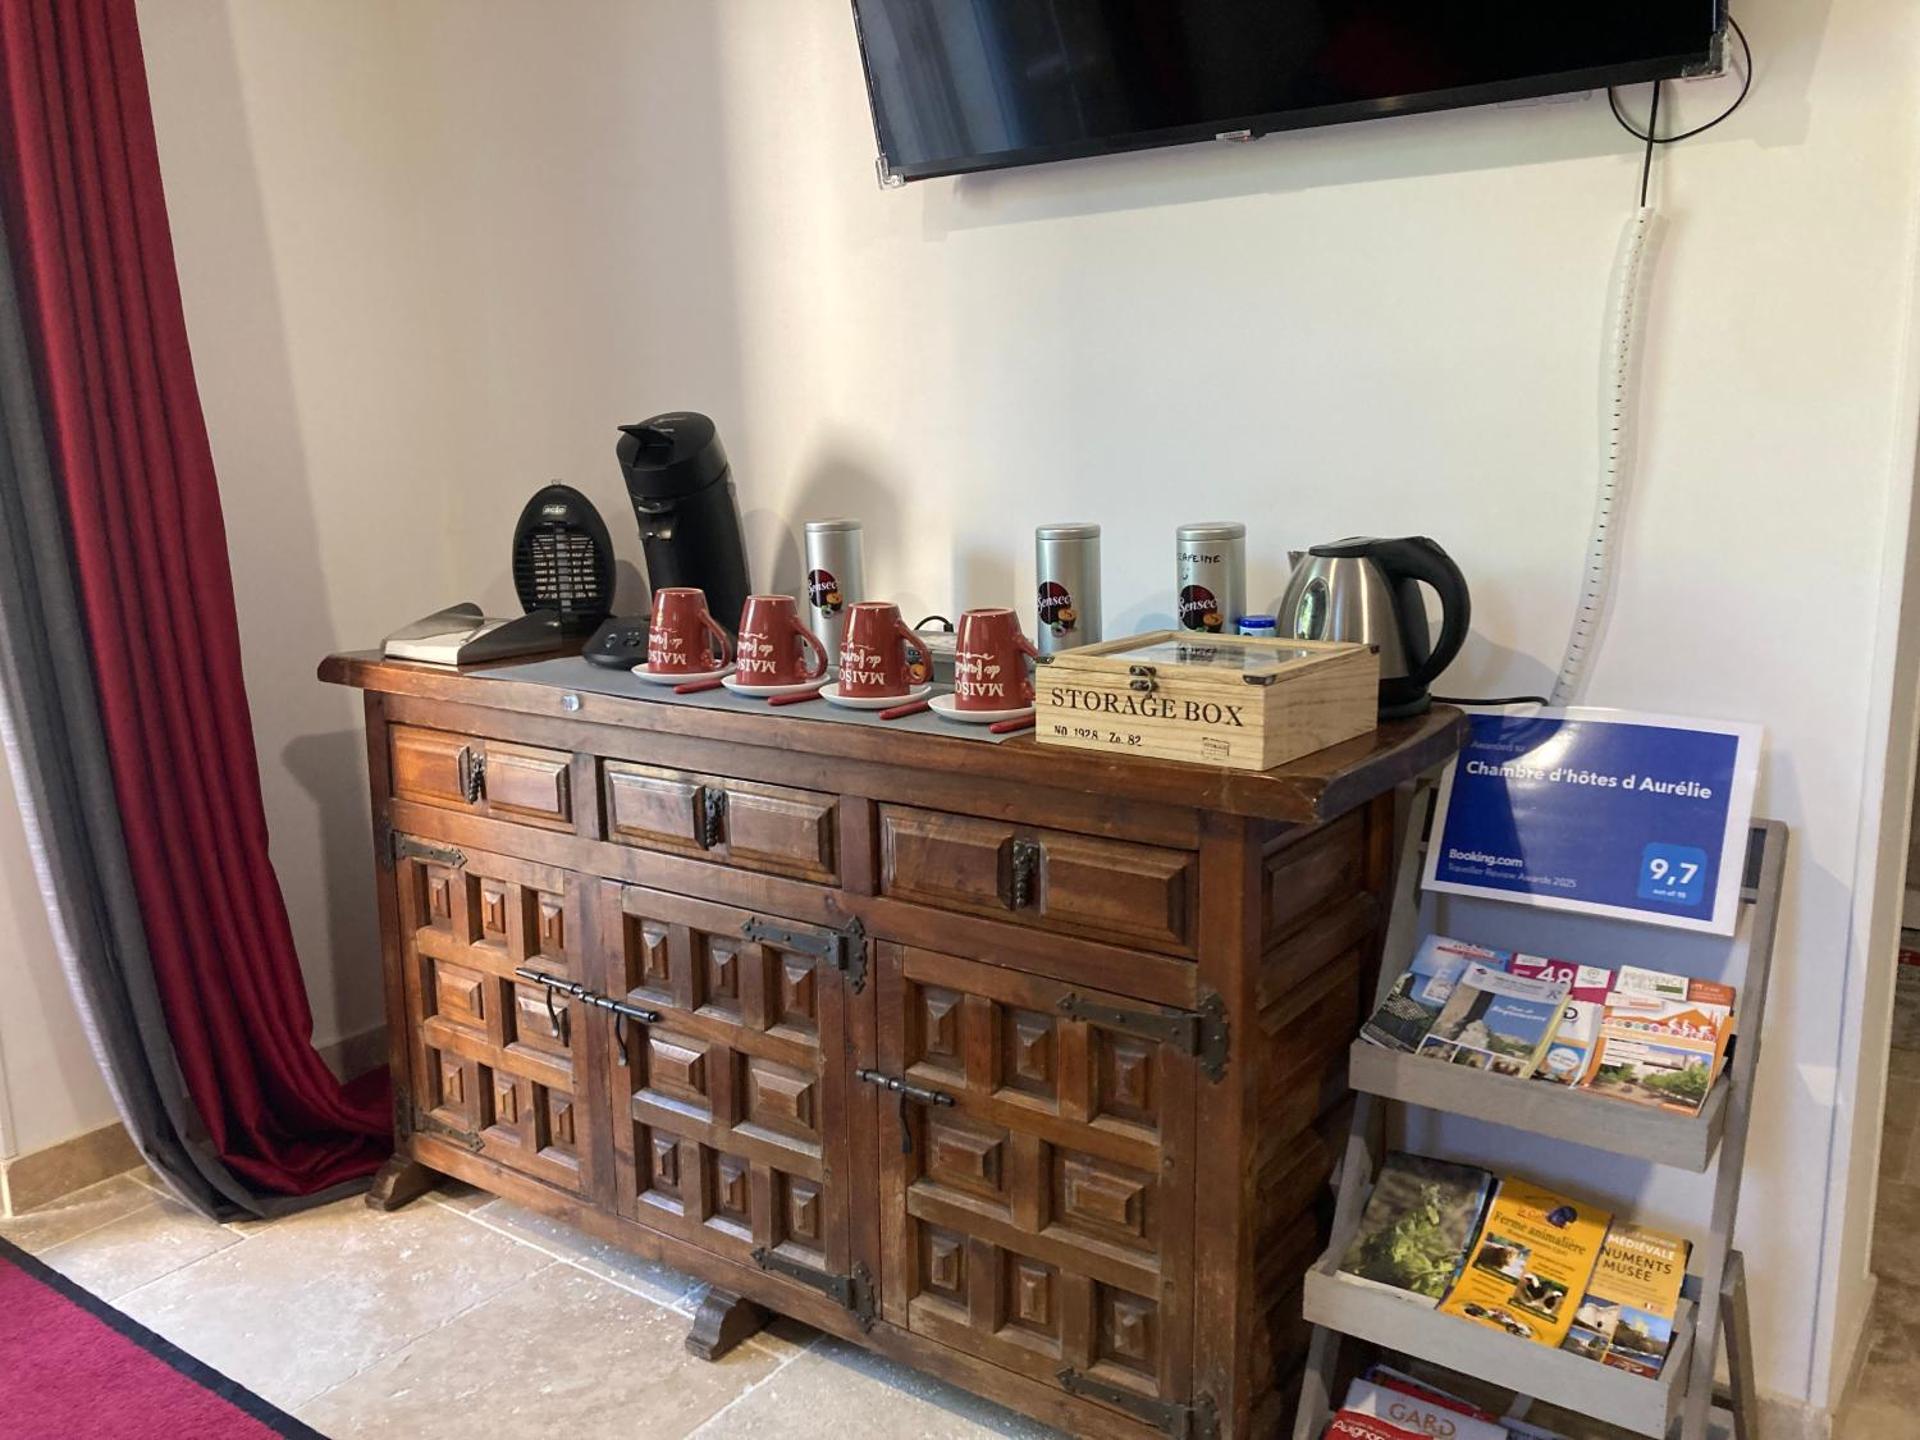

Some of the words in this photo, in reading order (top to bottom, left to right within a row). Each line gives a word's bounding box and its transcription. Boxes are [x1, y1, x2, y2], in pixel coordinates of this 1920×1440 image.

[1051, 687, 1177, 719] STORAGE
[1184, 700, 1245, 728] BOX
[1127, 734, 1144, 747] 82
[1466, 760, 1546, 780] Chambre
[1622, 774, 1636, 789] d
[1639, 776, 1712, 799] Aurélie
[1448, 848, 1523, 867] Booking.com
[1650, 858, 1699, 886] 9,7
[1388, 1403, 1456, 1437] GARD
